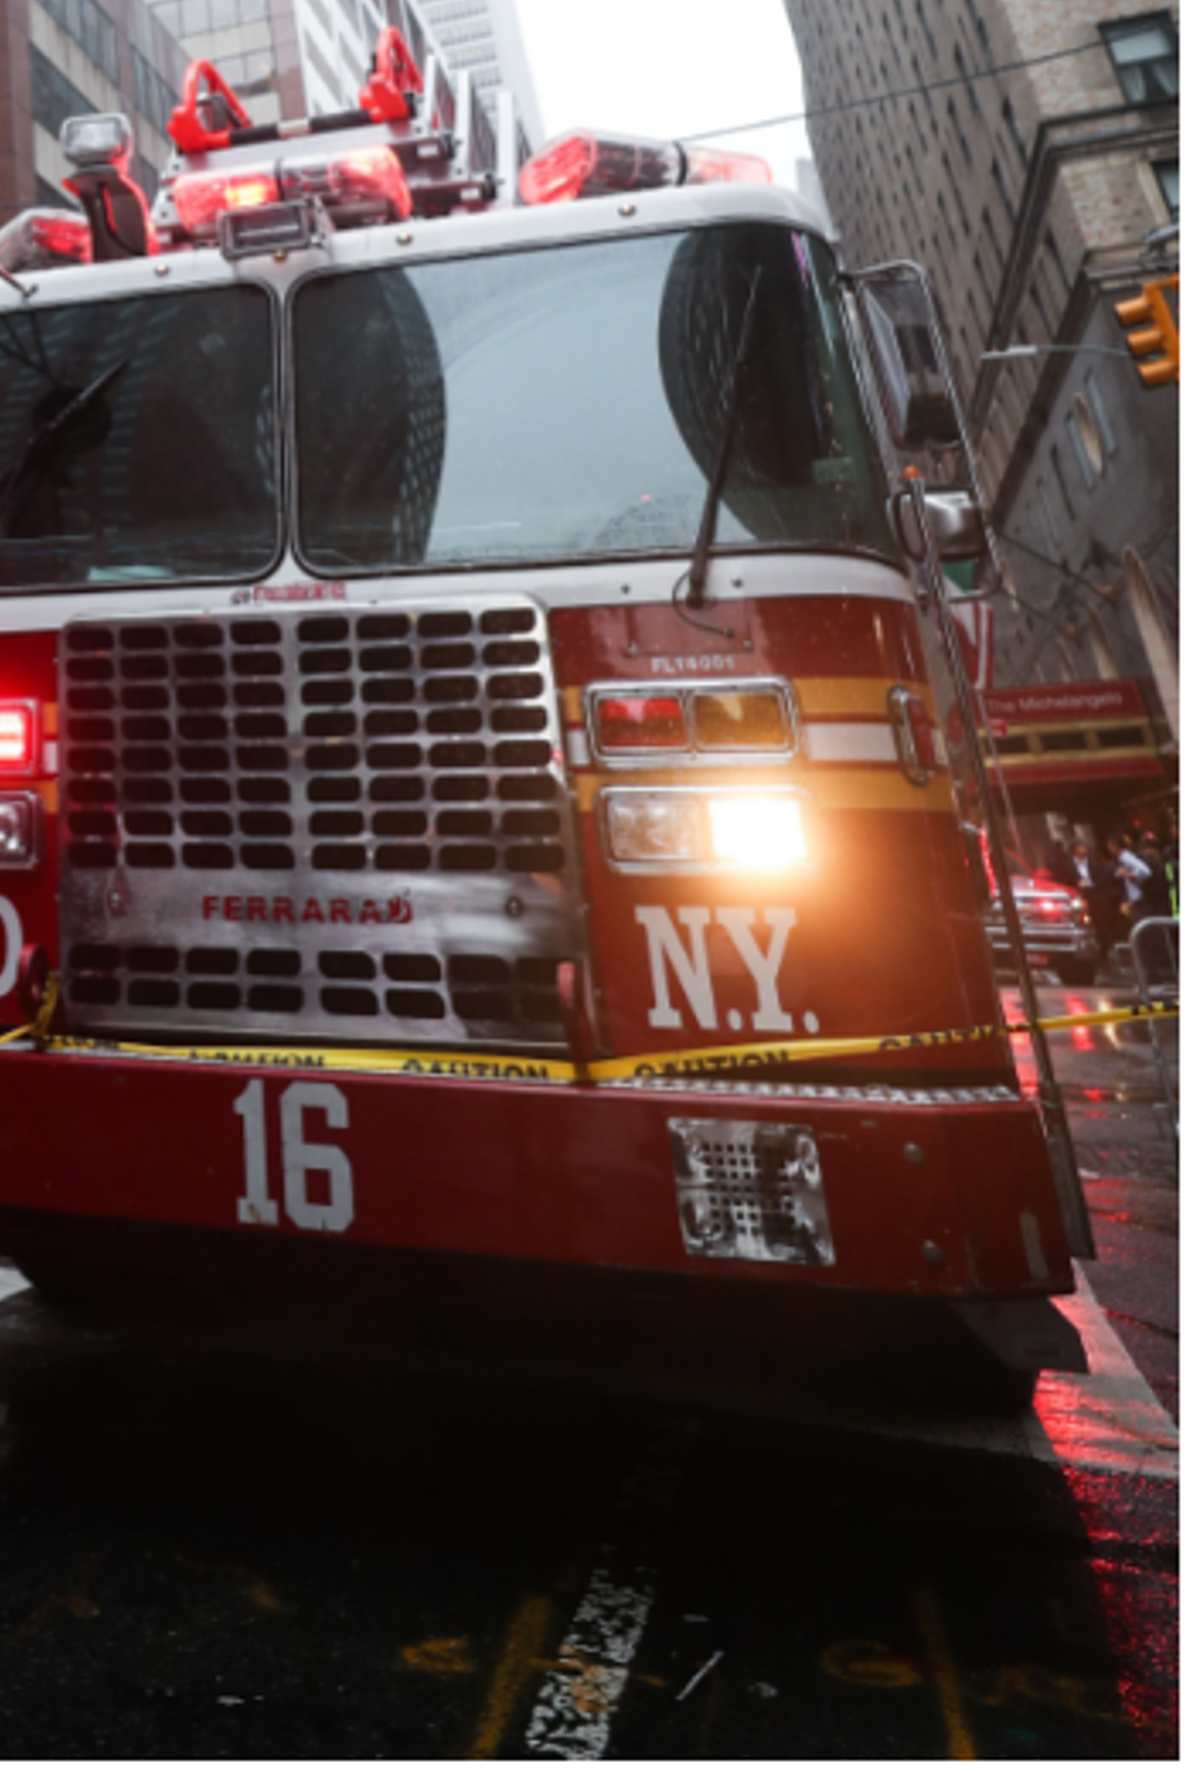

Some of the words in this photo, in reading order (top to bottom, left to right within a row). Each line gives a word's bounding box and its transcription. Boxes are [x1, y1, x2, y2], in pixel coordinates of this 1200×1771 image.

[1018, 692, 1123, 712] Michelangelo
[202, 895, 382, 924] FERRARA
[635, 905, 819, 1034] N.Y.
[233, 1077, 355, 1233] 16
